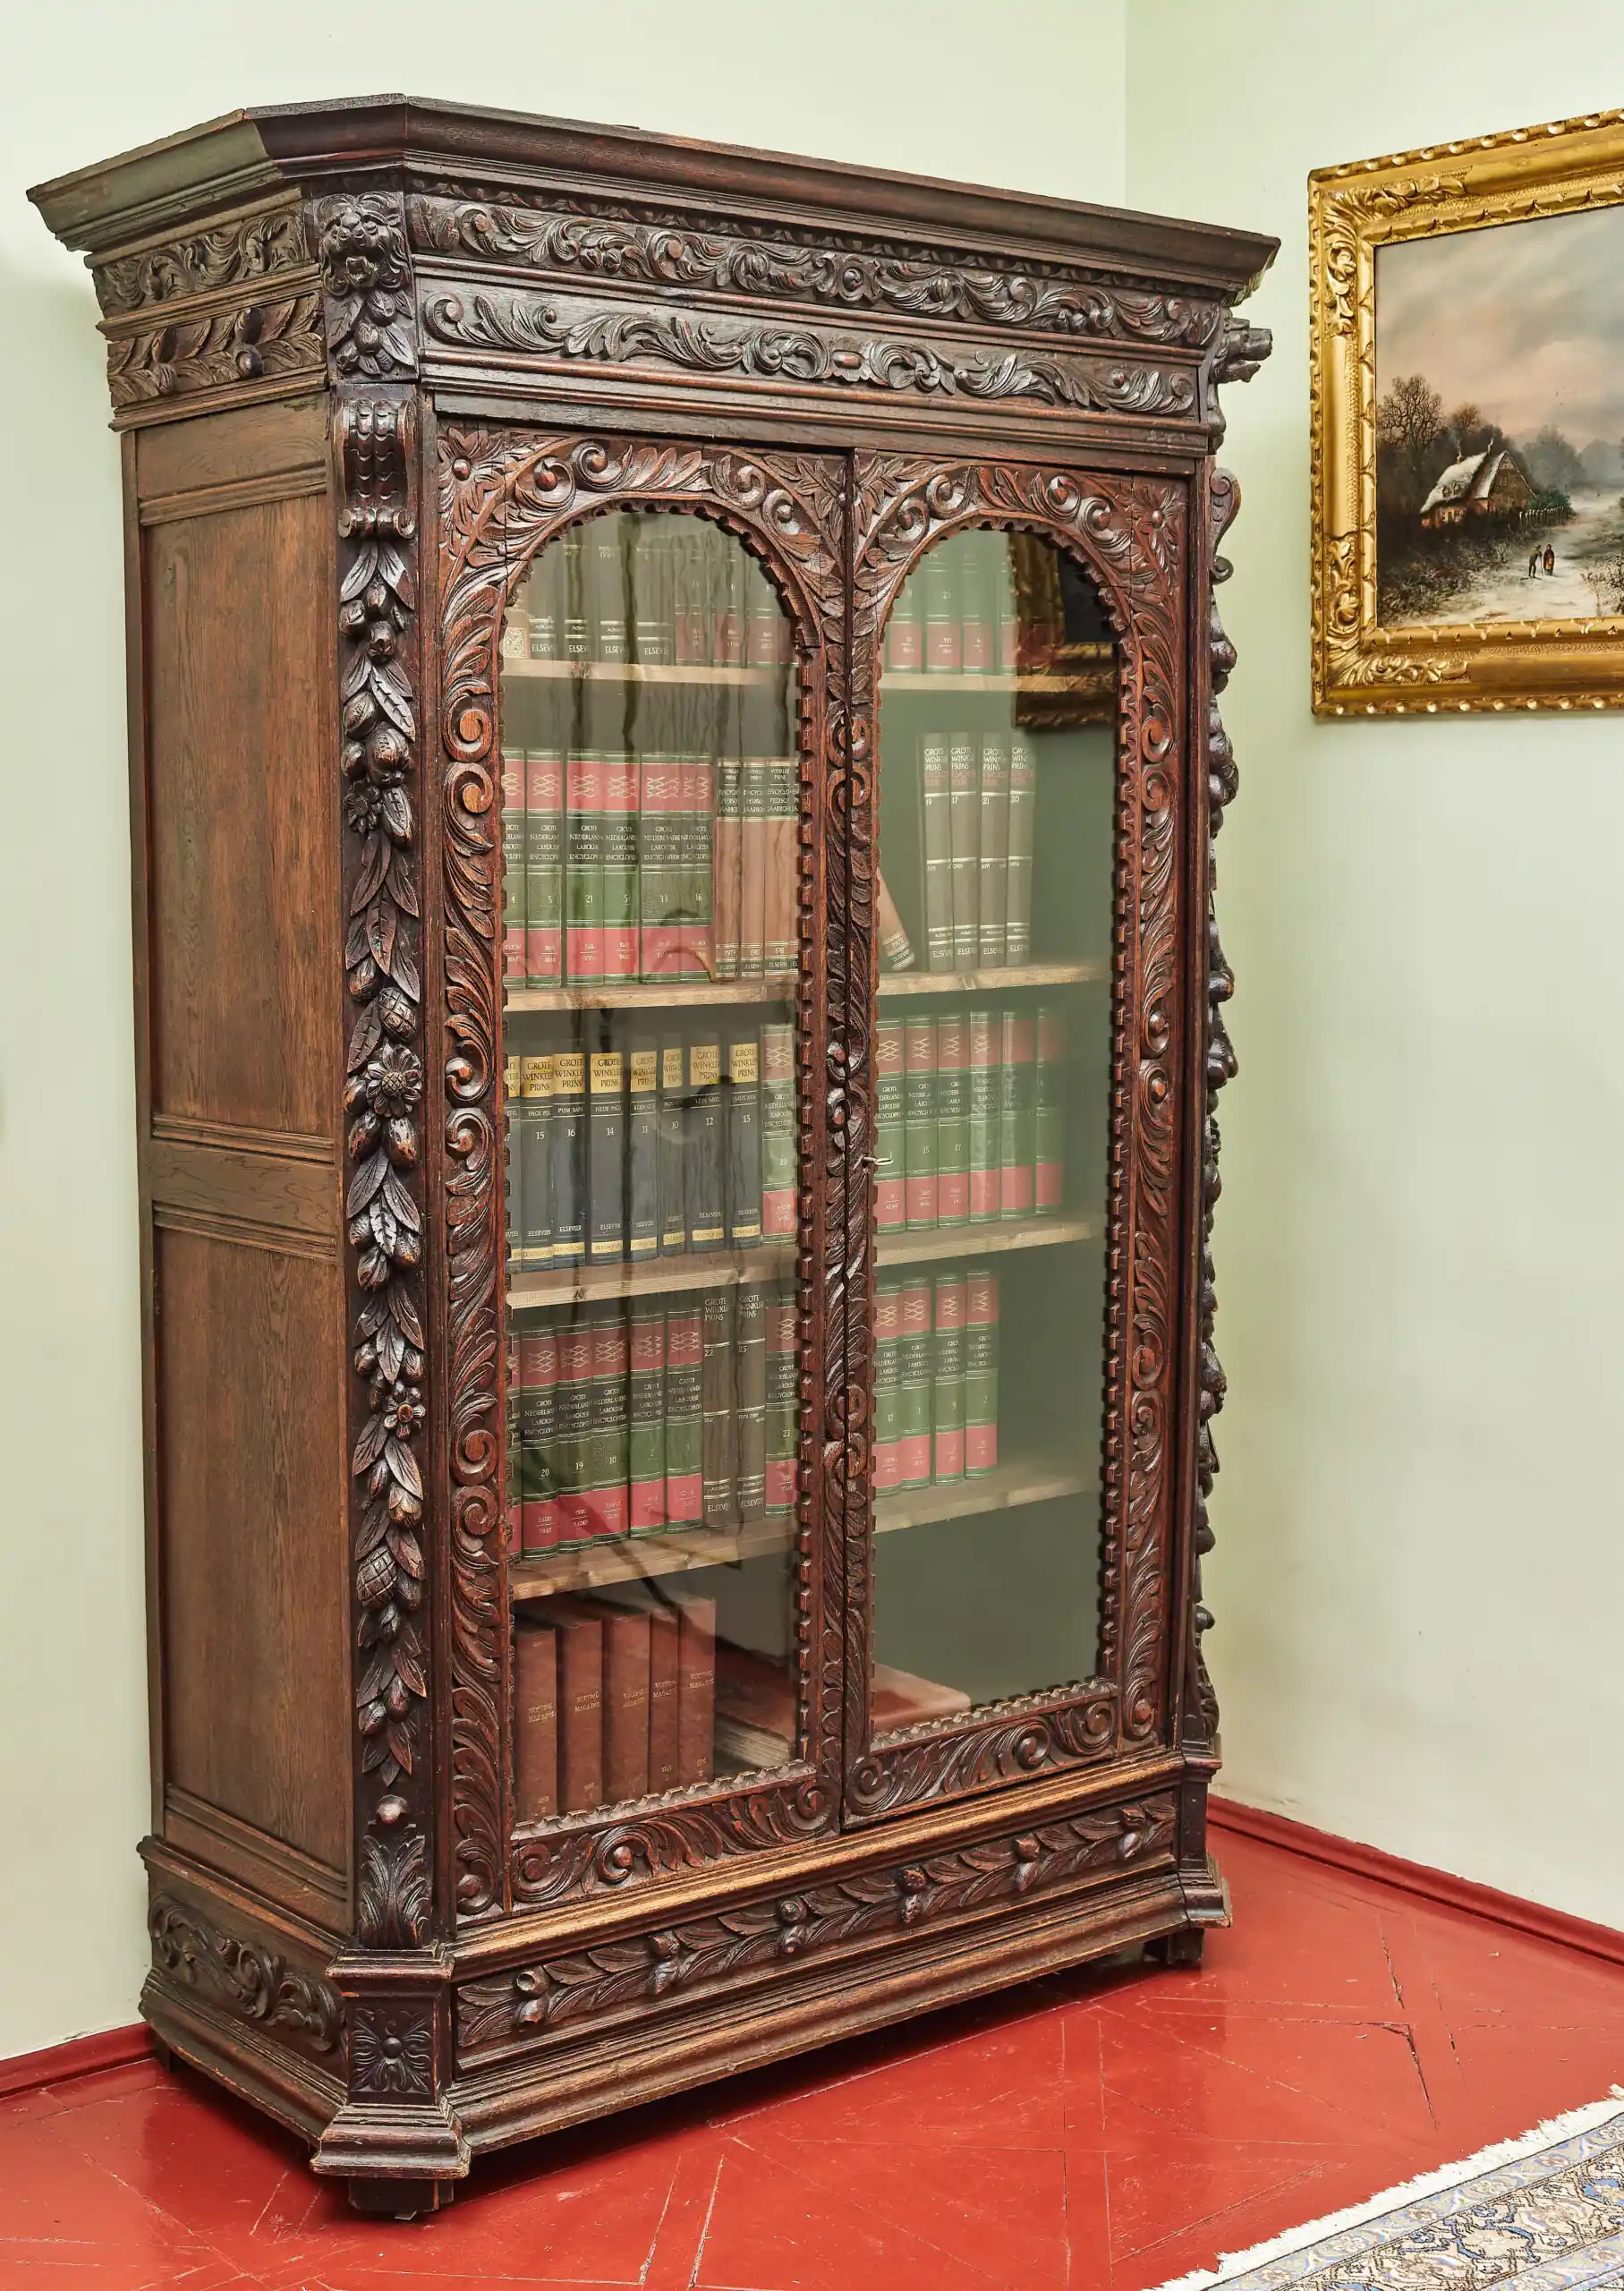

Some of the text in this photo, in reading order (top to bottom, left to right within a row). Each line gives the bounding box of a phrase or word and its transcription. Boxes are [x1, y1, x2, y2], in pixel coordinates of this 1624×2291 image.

[926, 797, 932, 805] 19
[952, 796, 958, 805] 17
[982, 796, 990, 805] 21
[1011, 796, 1020, 804] 20
[585, 895, 593, 903] 21
[528, 1062, 552, 1070] GROTE
[559, 1058, 583, 1067] GROTE
[598, 1058, 622, 1067] GROTE
[699, 1070, 718, 1079] PRINS
[737, 1069, 755, 1077] PRINS
[562, 1079, 582, 1088] PRINS
[600, 1079, 619, 1087] PRINS
[637, 1077, 654, 1086] PRINS
[530, 1083, 550, 1092] PRINS
[706, 1117, 714, 1126] 12
[743, 1114, 752, 1123] 13
[641, 1125, 648, 1134] 11
[672, 1121, 679, 1129] 10
[536, 1131, 545, 1140] 15
[567, 1128, 576, 1137] 16
[607, 1128, 615, 1136] 14
[779, 1158, 787, 1166] 20
[558, 1224, 582, 1232] ELSEVIER
[599, 1222, 621, 1231] ELSEVIER
[528, 1229, 551, 1237] ELSEVIER
[705, 1297, 727, 1306] GROTE
[704, 1313, 724, 1322] PRINS
[704, 1349, 714, 1357] 22
[738, 1345, 747, 1353] 25
[887, 1414, 894, 1422] 12
[782, 1429, 791, 1438] 23
[608, 1456, 616, 1465] 10
[575, 1461, 583, 1470] 19
[541, 1469, 549, 1478] 20
